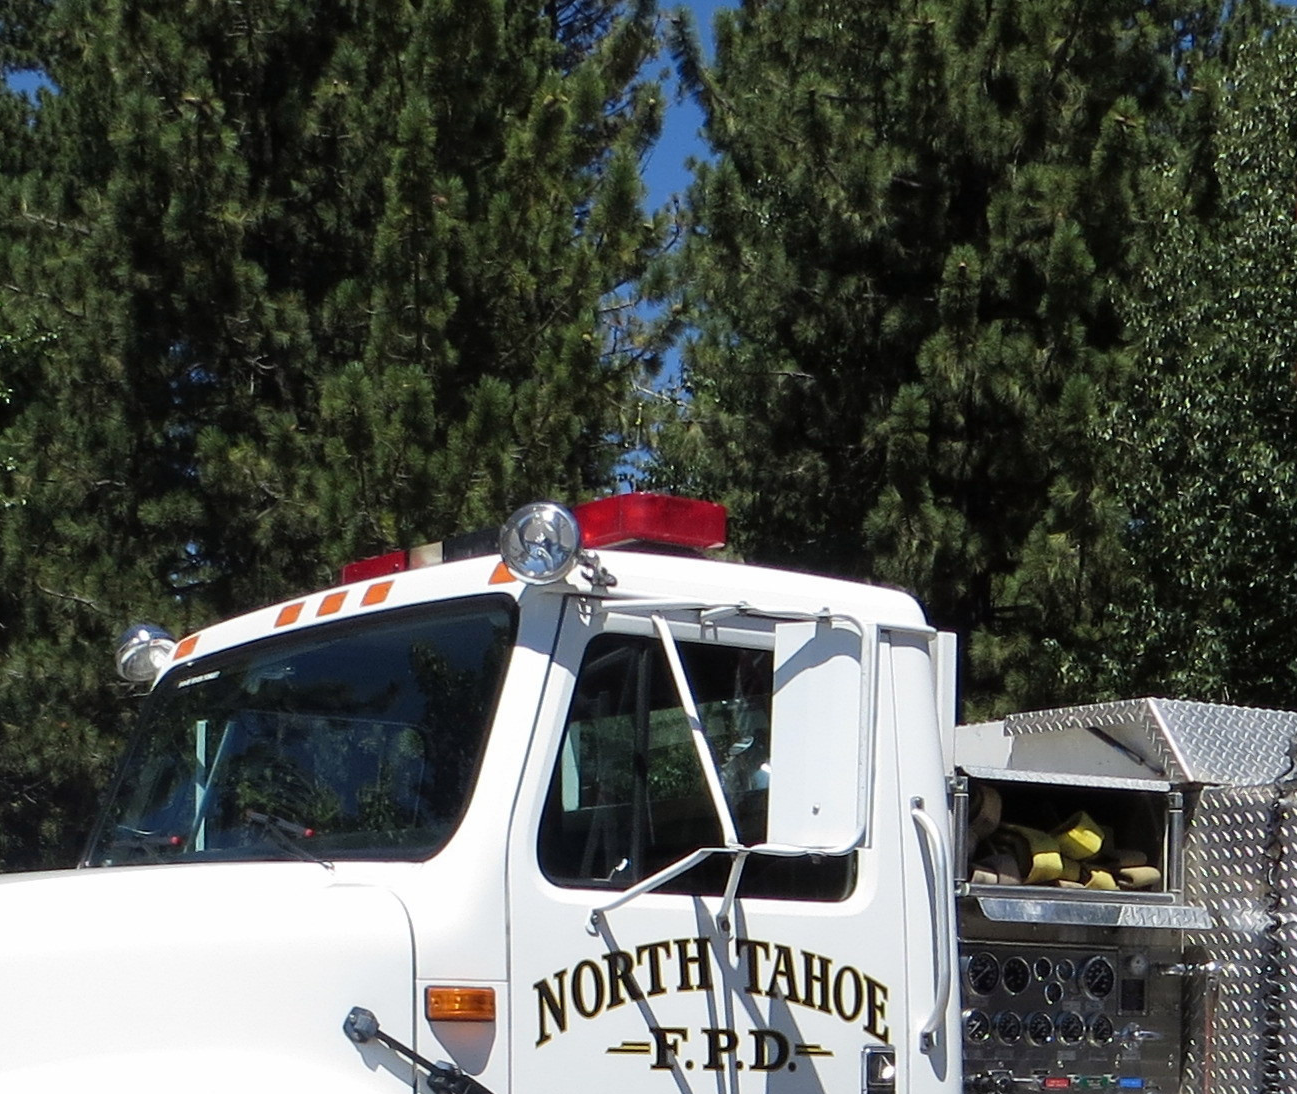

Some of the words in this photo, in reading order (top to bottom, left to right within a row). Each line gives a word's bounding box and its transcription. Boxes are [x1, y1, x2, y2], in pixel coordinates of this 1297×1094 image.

[533, 937, 713, 1048] NORTH
[735, 937, 892, 1045] TAHOE
[649, 1027, 797, 1073] F.P.D.
